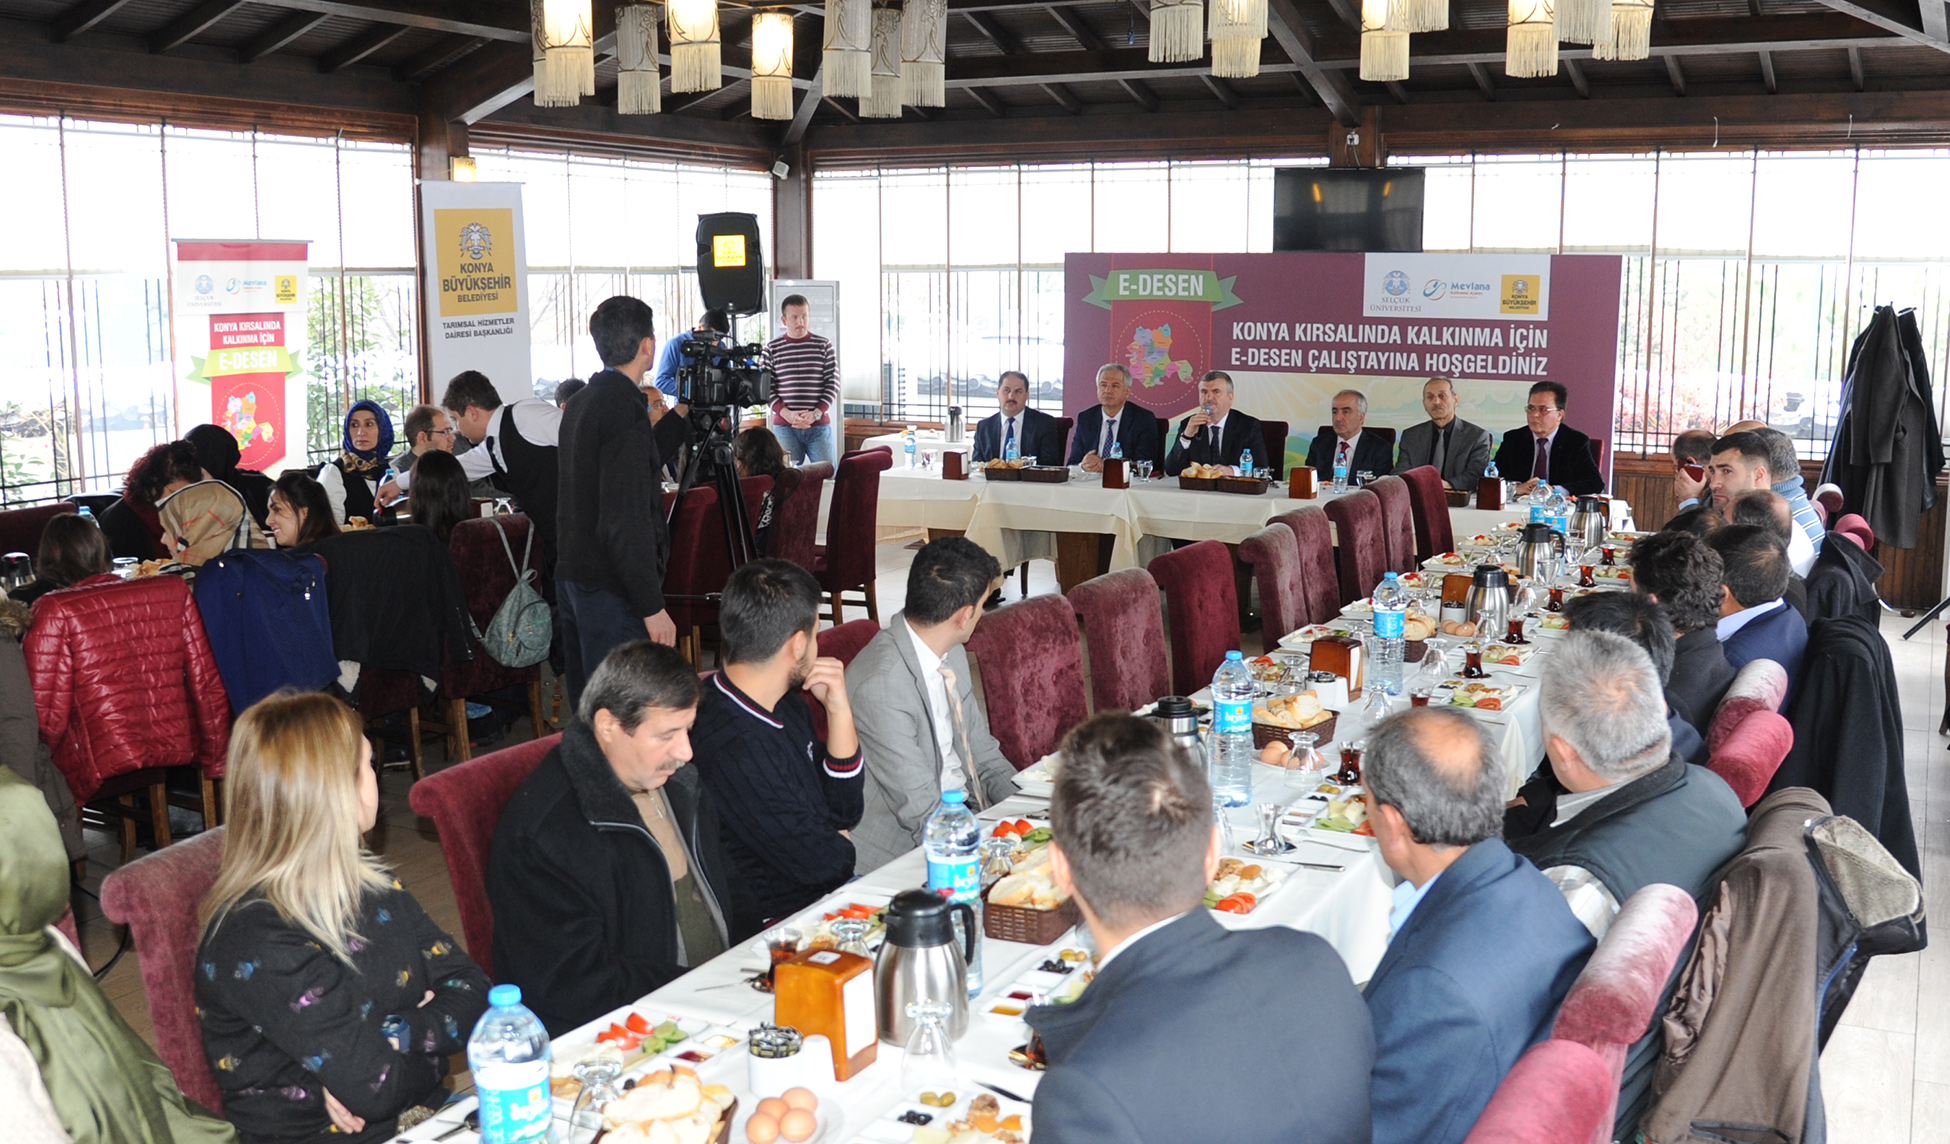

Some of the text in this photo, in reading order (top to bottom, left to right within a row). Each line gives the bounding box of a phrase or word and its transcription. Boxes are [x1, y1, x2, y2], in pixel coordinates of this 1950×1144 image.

[460, 262, 494, 274] KONYA
[442, 273, 512, 292] BÜYÜKŞEHİR
[1118, 273, 1204, 297] E-DESEN
[1450, 281, 1491, 291] Mevlana
[457, 291, 499, 302] BELEDİYESİ
[1369, 304, 1422, 313] ÜNİVERSİTESİ
[213, 320, 281, 332] KONYA KIRSALINDA
[442, 317, 515, 330] TARIMSAL HİZMETLER
[222, 331, 275, 345] KALKINMA İÇİN
[445, 327, 513, 339] DAİRESİ BAŞKANLIĞI
[1232, 321, 1548, 353] KONYA KIRSALINDA KALKINMA İÇİN
[219, 350, 278, 371] E-DESEN
[1230, 347, 1548, 377] E-DESEN ÇALIŞTAYINA HOŞGELDİNİZ
